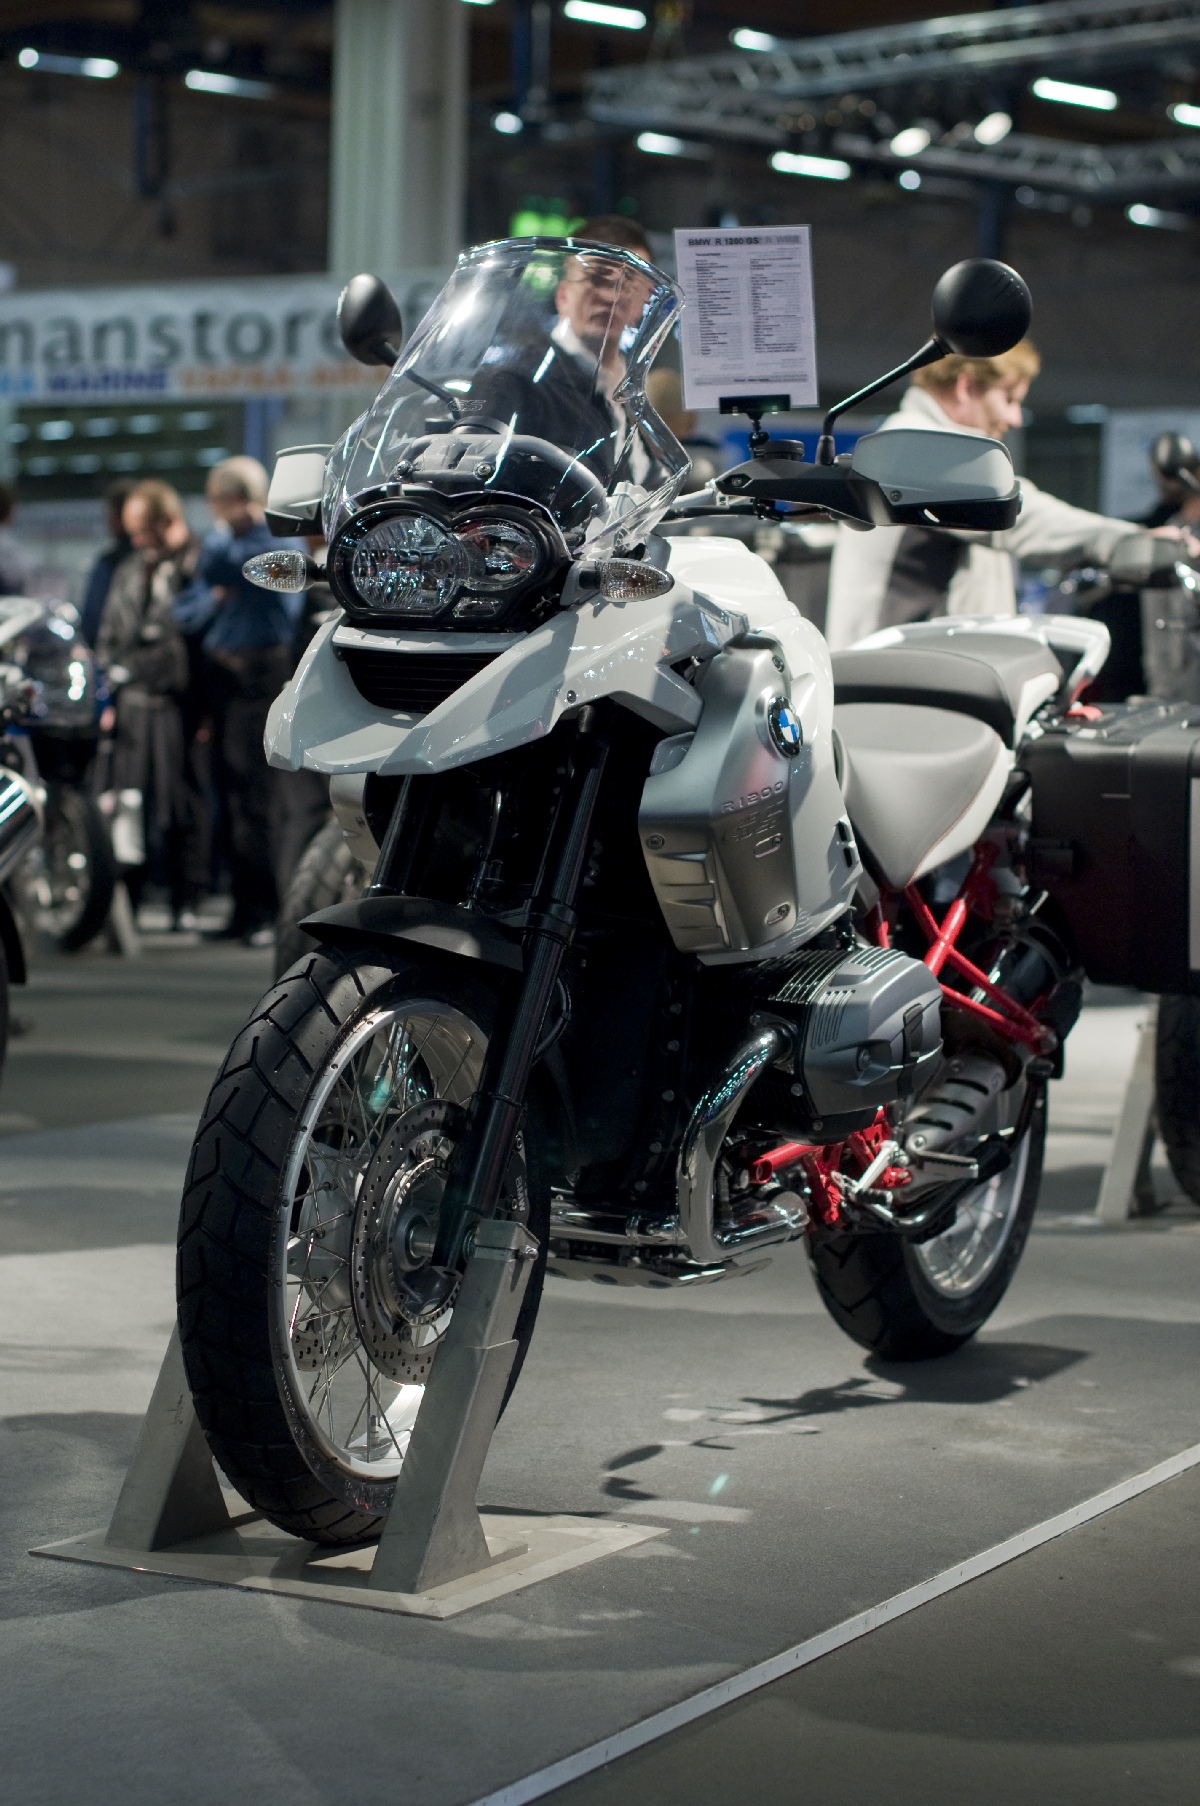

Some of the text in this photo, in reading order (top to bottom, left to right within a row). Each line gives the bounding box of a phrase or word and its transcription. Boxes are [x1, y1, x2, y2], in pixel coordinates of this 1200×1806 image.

[688, 238, 711, 246] BMW
[715, 238, 722, 246] R
[725, 237, 744, 245] 1200
[746, 236, 760, 245] GS
[721, 781, 784, 814] R1200
[515, 1175, 526, 1211] BMW
